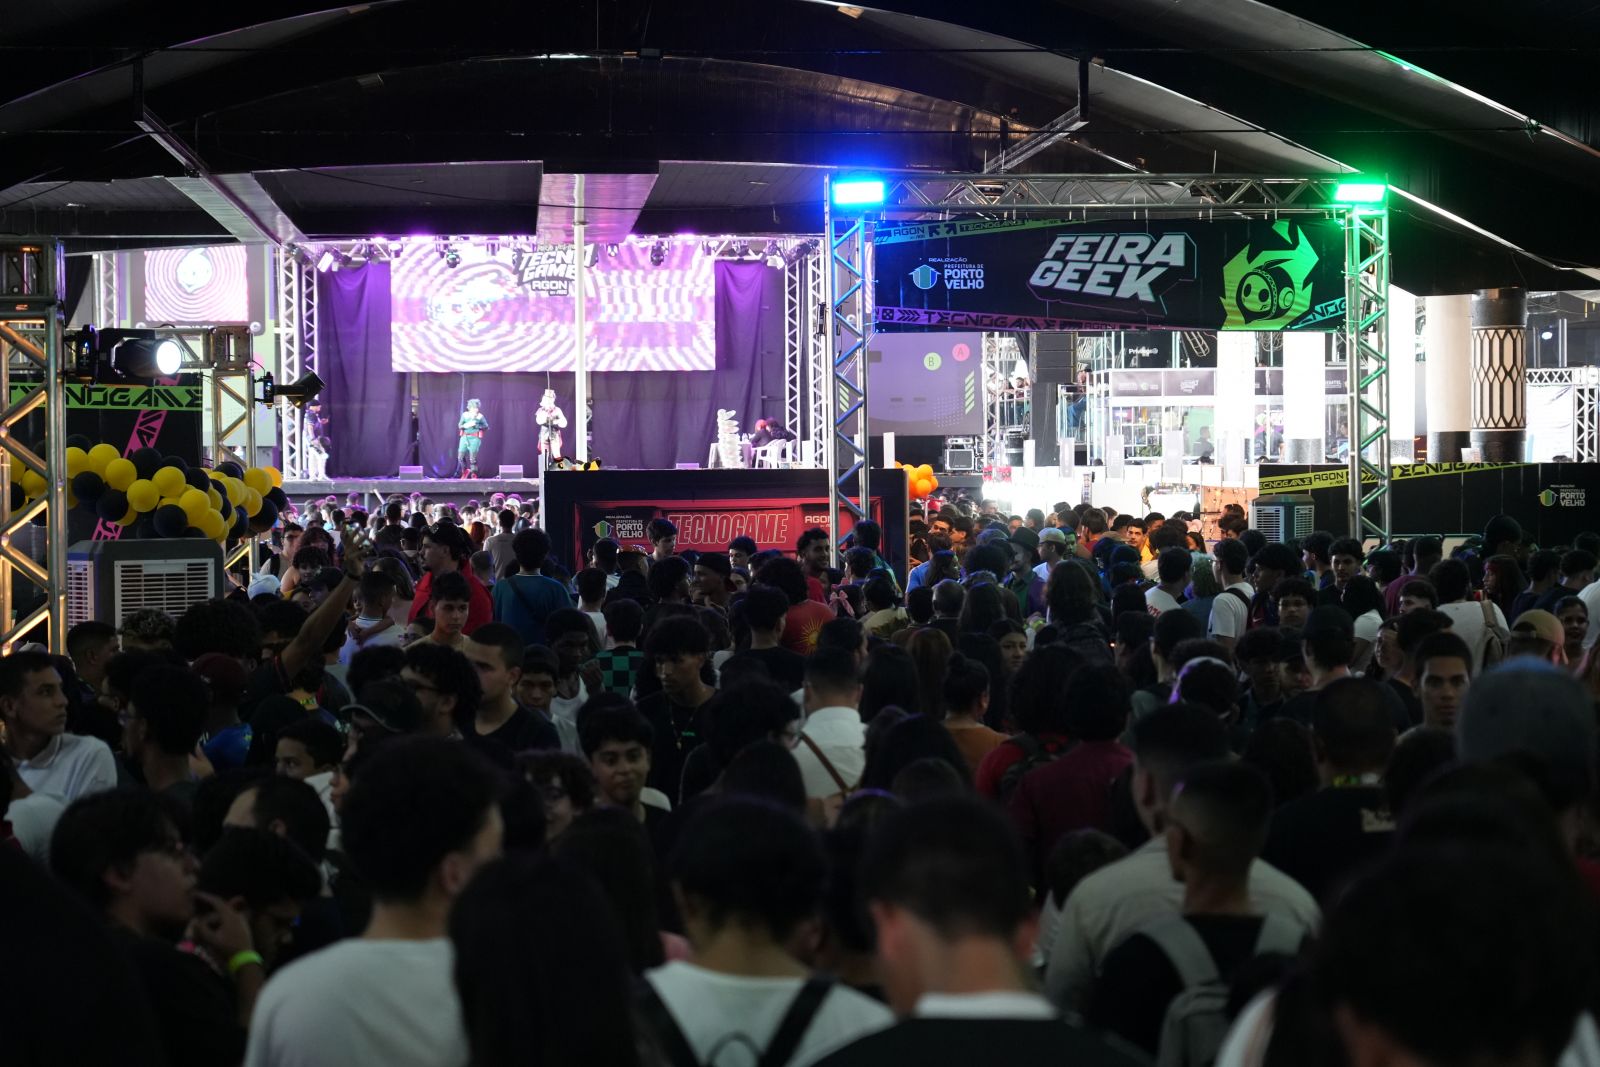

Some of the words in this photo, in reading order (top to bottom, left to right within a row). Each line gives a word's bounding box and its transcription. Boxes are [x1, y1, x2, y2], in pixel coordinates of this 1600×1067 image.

[893, 227, 925, 236] AGON
[1043, 234, 1186, 267] FEIRA
[944, 268, 984, 279] PORTO
[532, 280, 567, 290] AGON
[944, 278, 984, 290] VELHO
[1028, 260, 1169, 303] GEEK
[924, 310, 1057, 330] TECNOGAME
[1314, 472, 1344, 482] AGON
[1559, 499, 1586, 507] VELHO
[615, 523, 643, 531] PORTO
[668, 513, 789, 545] TECNOGAME
[615, 530, 644, 538] VELHO
